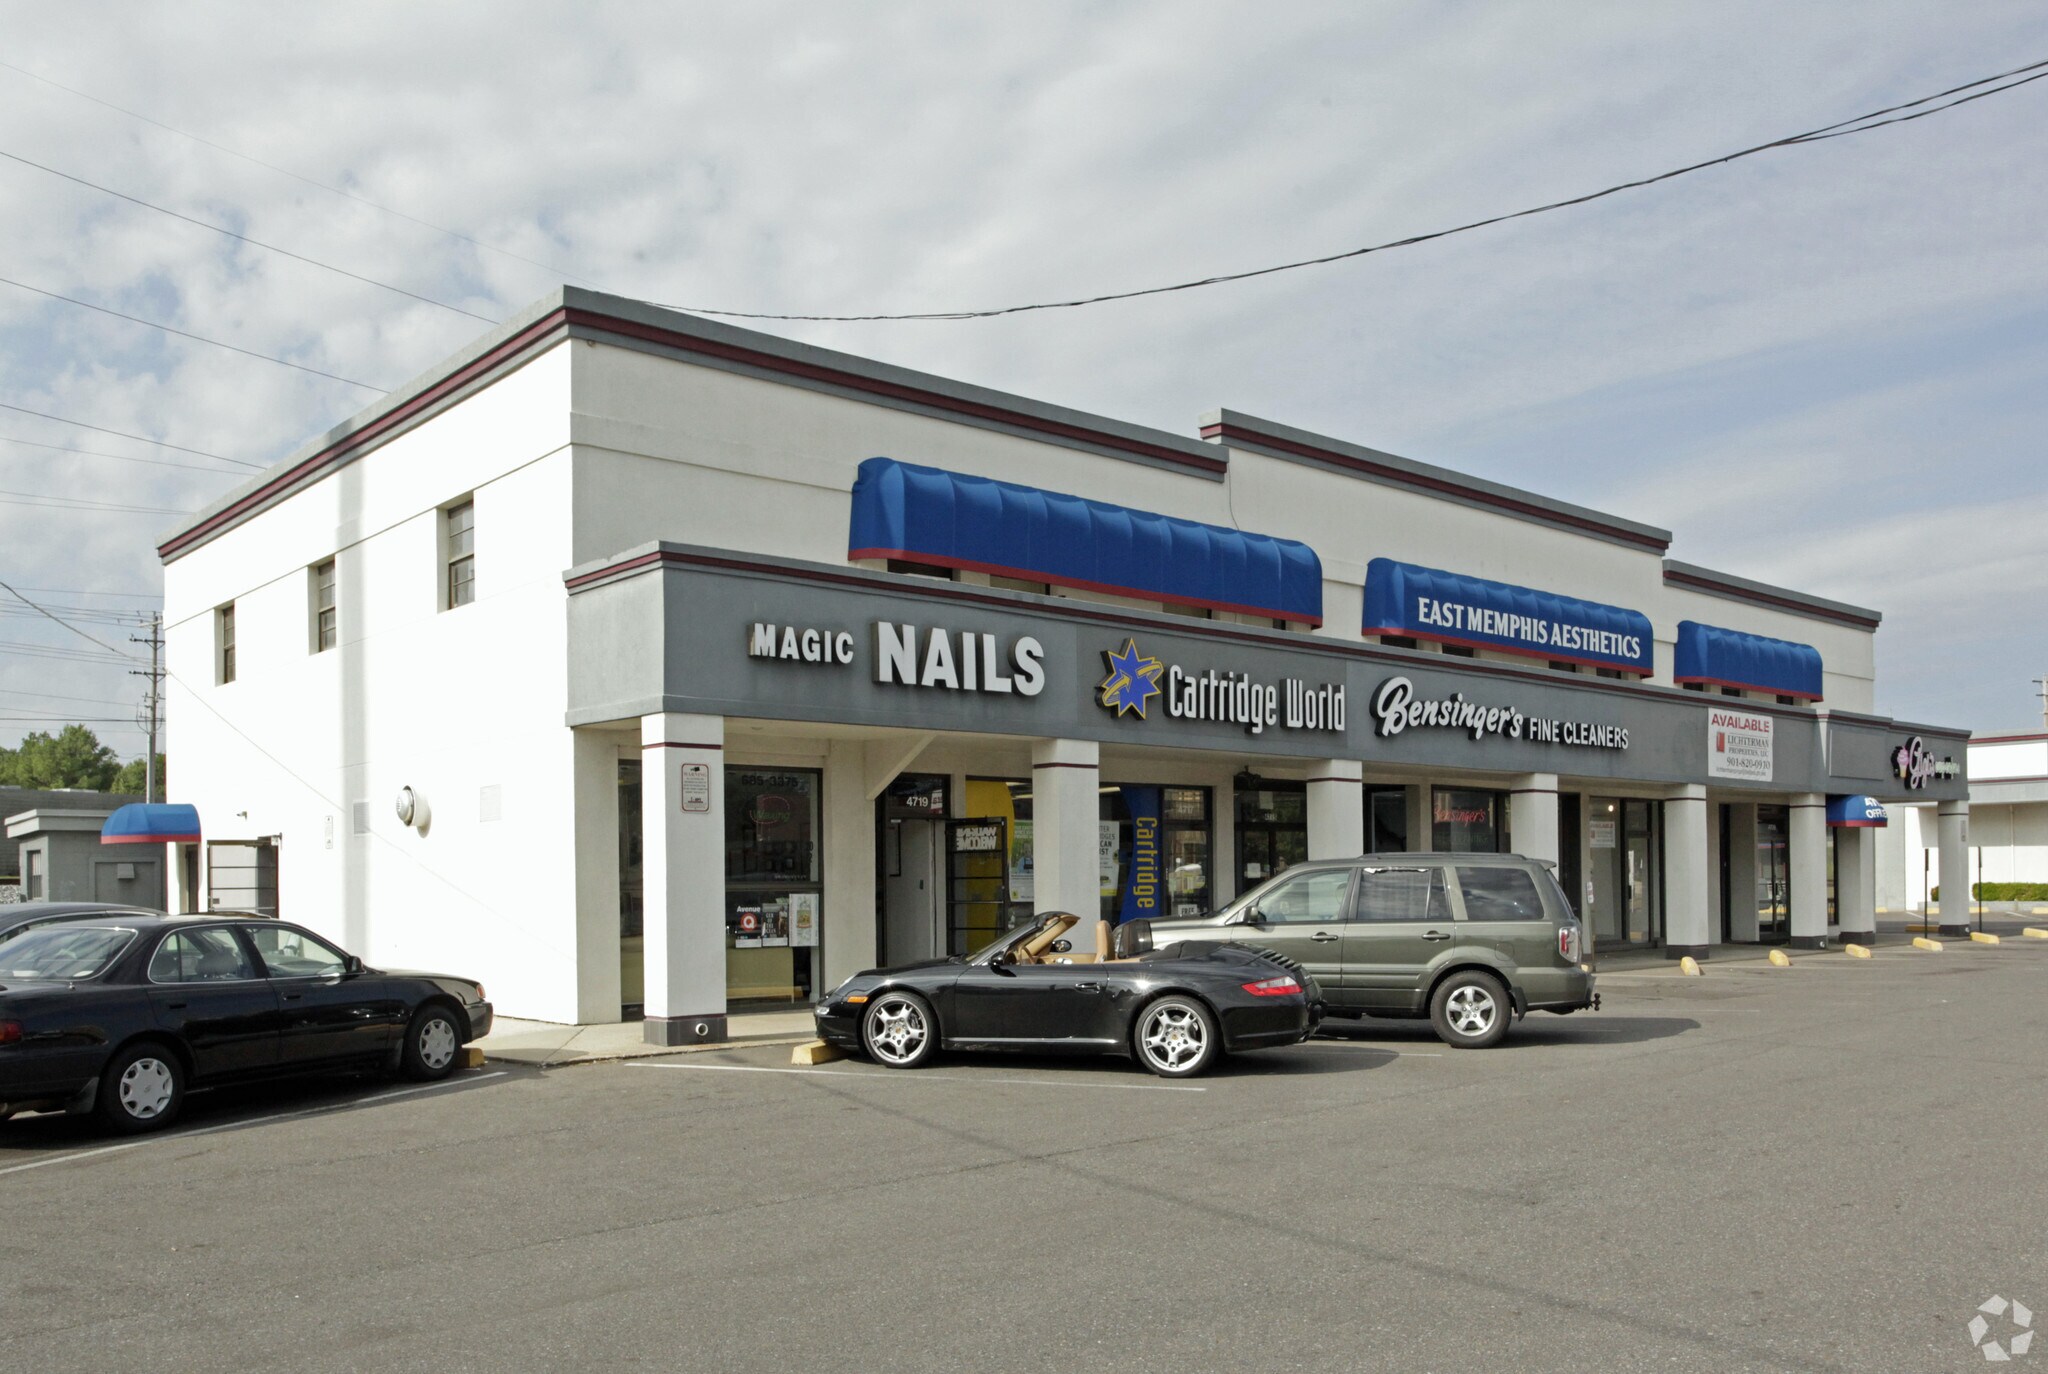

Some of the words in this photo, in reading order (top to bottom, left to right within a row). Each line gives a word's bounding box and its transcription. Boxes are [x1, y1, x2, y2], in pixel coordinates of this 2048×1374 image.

[1418, 597, 1465, 629] EAST
[1467, 606, 1548, 644] MEMPHIS
[1550, 622, 1641, 659] AESTHETICS
[750, 622, 854, 664] MAGIC
[873, 621, 1046, 697] NAILS
[1168, 664, 1277, 734] Cartridge
[1283, 677, 1345, 731] World
[1375, 676, 1524, 740] Bensinger's
[1529, 717, 1560, 742] FINE
[1562, 721, 1629, 750] CLEANERS
[1711, 713, 1770, 733] AVAILABLE
[1727, 735, 1769, 748] LICHTERMAN
[1726, 757, 1771, 769] 901-820-0910
[906, 796, 929, 807] 4719
[1133, 817, 1158, 908] Cartridge
[736, 905, 761, 913] Avenue
[743, 915, 755, 929] Q
